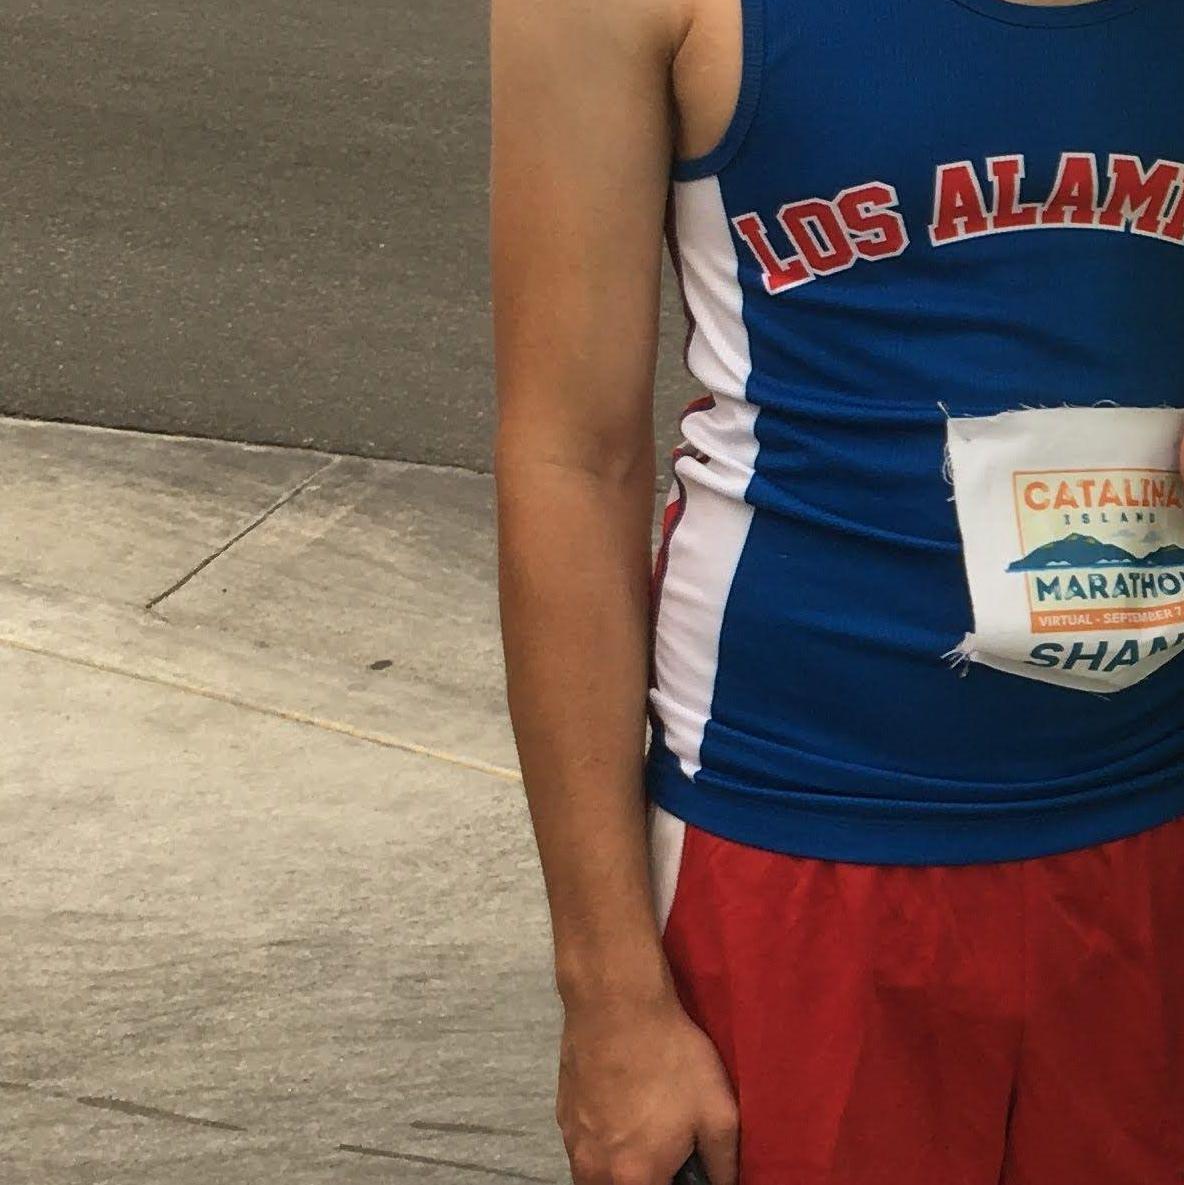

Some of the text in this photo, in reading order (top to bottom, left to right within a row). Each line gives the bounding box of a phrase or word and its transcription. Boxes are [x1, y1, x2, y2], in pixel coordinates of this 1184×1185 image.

[732, 181, 910, 296] LOS
[1023, 479, 1183, 511] CATALINA
[1063, 512, 1156, 525] ISLAND
[1039, 614, 1093, 627] VIRTUAL
[1103, 608, 1173, 624] SEPTEMBER
